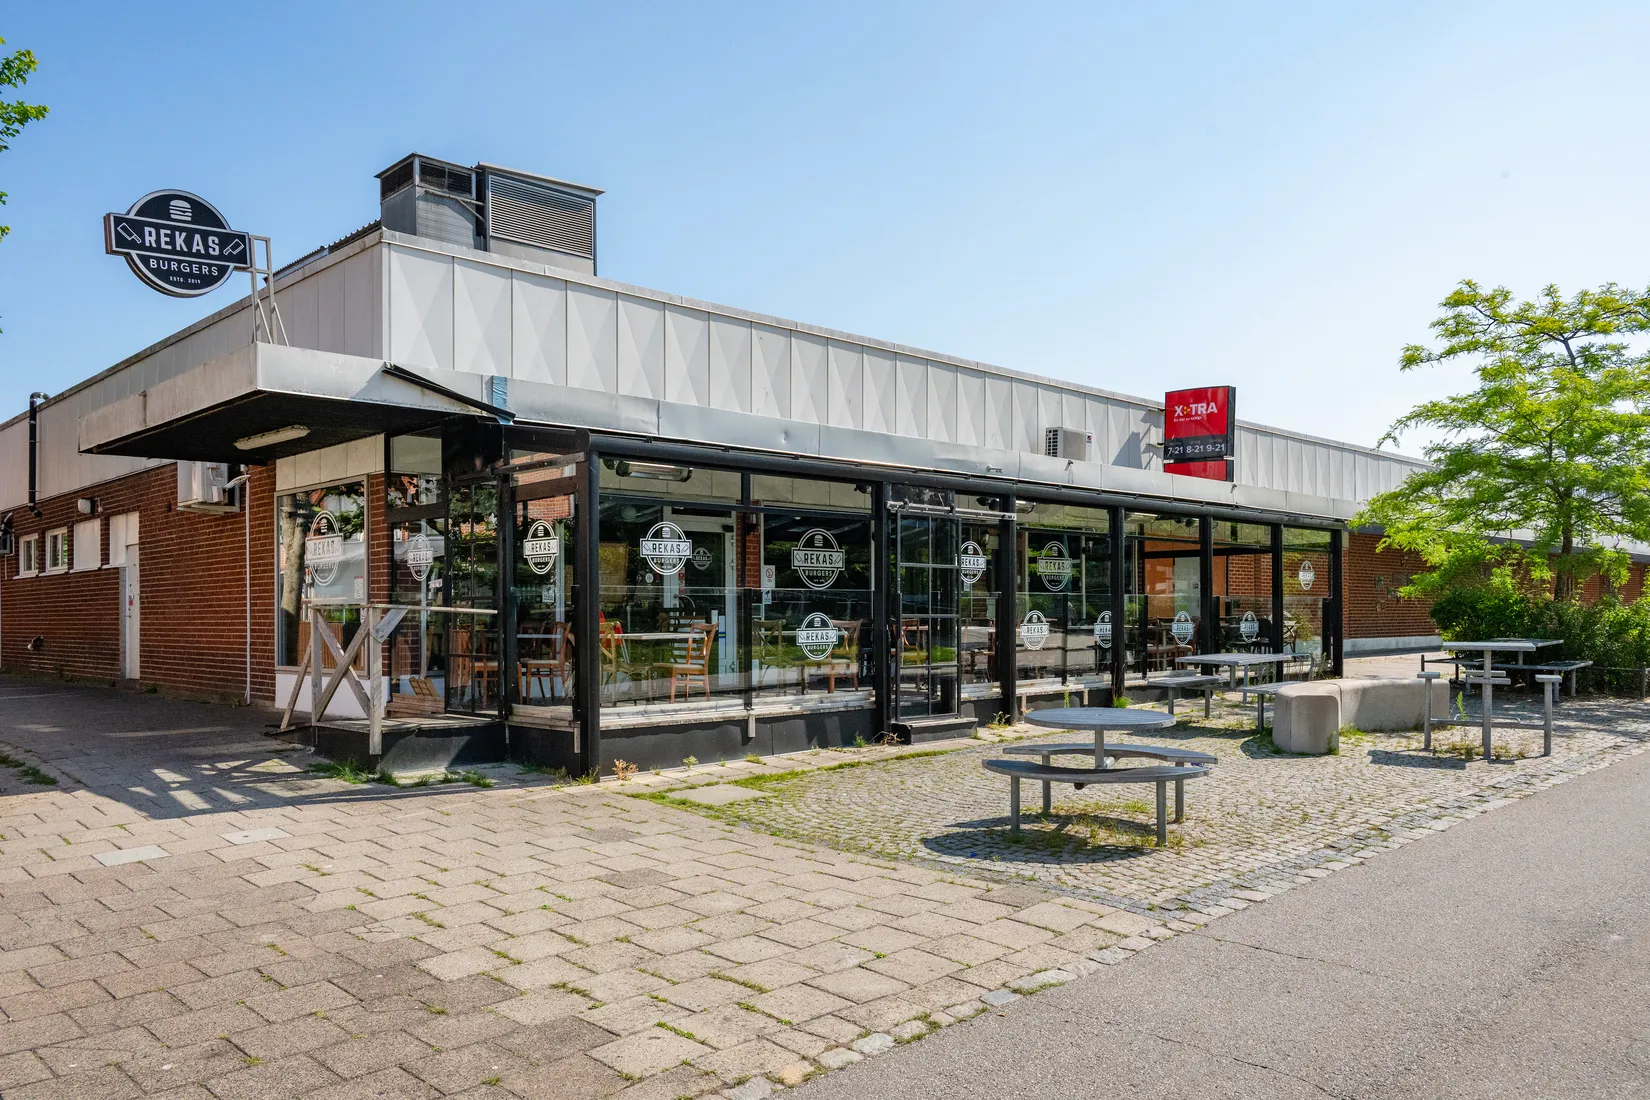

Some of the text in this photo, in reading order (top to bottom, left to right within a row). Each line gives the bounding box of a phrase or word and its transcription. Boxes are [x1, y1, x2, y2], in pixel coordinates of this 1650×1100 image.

[144, 226, 220, 256] REKAS
[149, 258, 218, 276] BURGERS
[1168, 443, 1225, 456] 7-21 8-21 9-21
[313, 540, 335, 556] REKAS
[531, 541, 551, 553] REKAS
[652, 542, 681, 554] REKAS
[804, 552, 834, 565] REKAS
[961, 558, 980, 567] REKAS
[1045, 561, 1065, 572] REKAS
[805, 569, 833, 577] BURGERS
[806, 631, 830, 641] REKAS
[1027, 626, 1043, 635] REKAS
